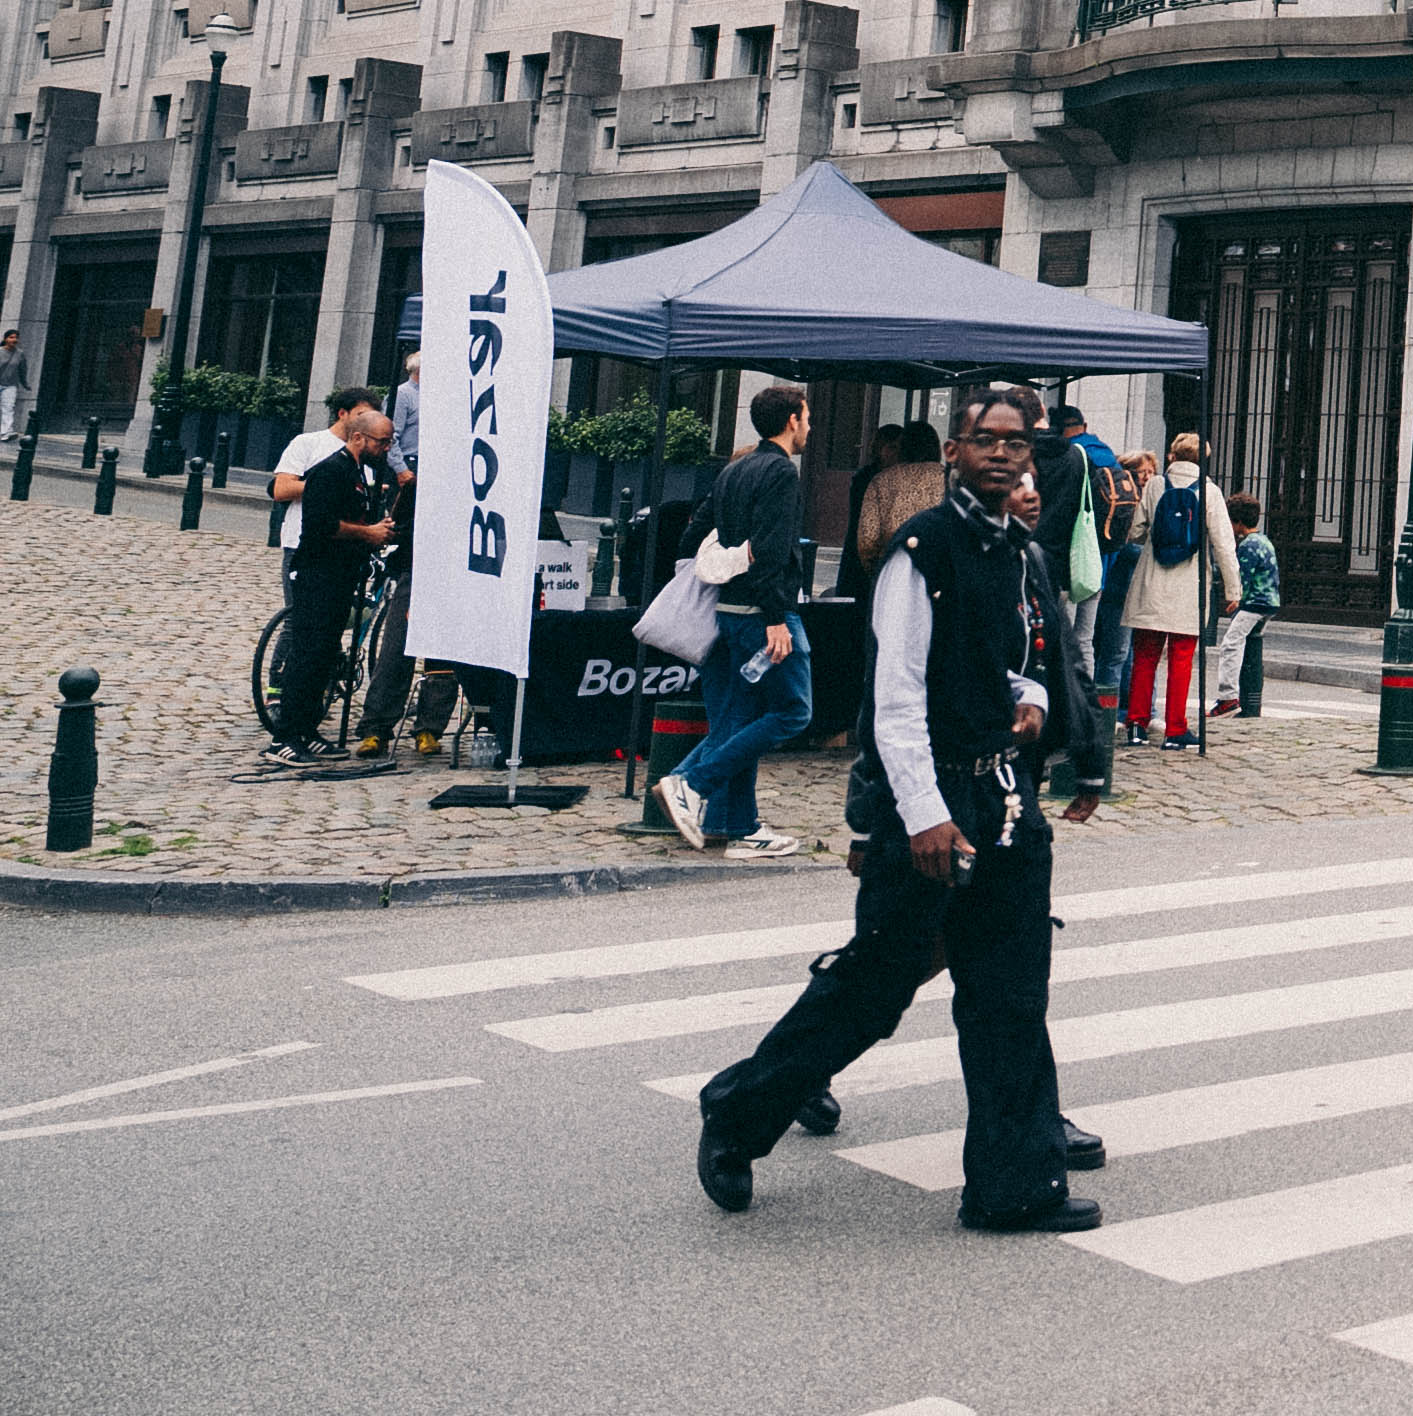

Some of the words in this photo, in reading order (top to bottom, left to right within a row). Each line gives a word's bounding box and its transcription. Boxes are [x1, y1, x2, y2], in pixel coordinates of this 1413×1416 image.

[467, 270, 507, 578] Bozar
[538, 564, 545, 573] a
[548, 562, 572, 573] walk
[556, 580, 580, 590] side
[578, 659, 700, 696] Bozar
